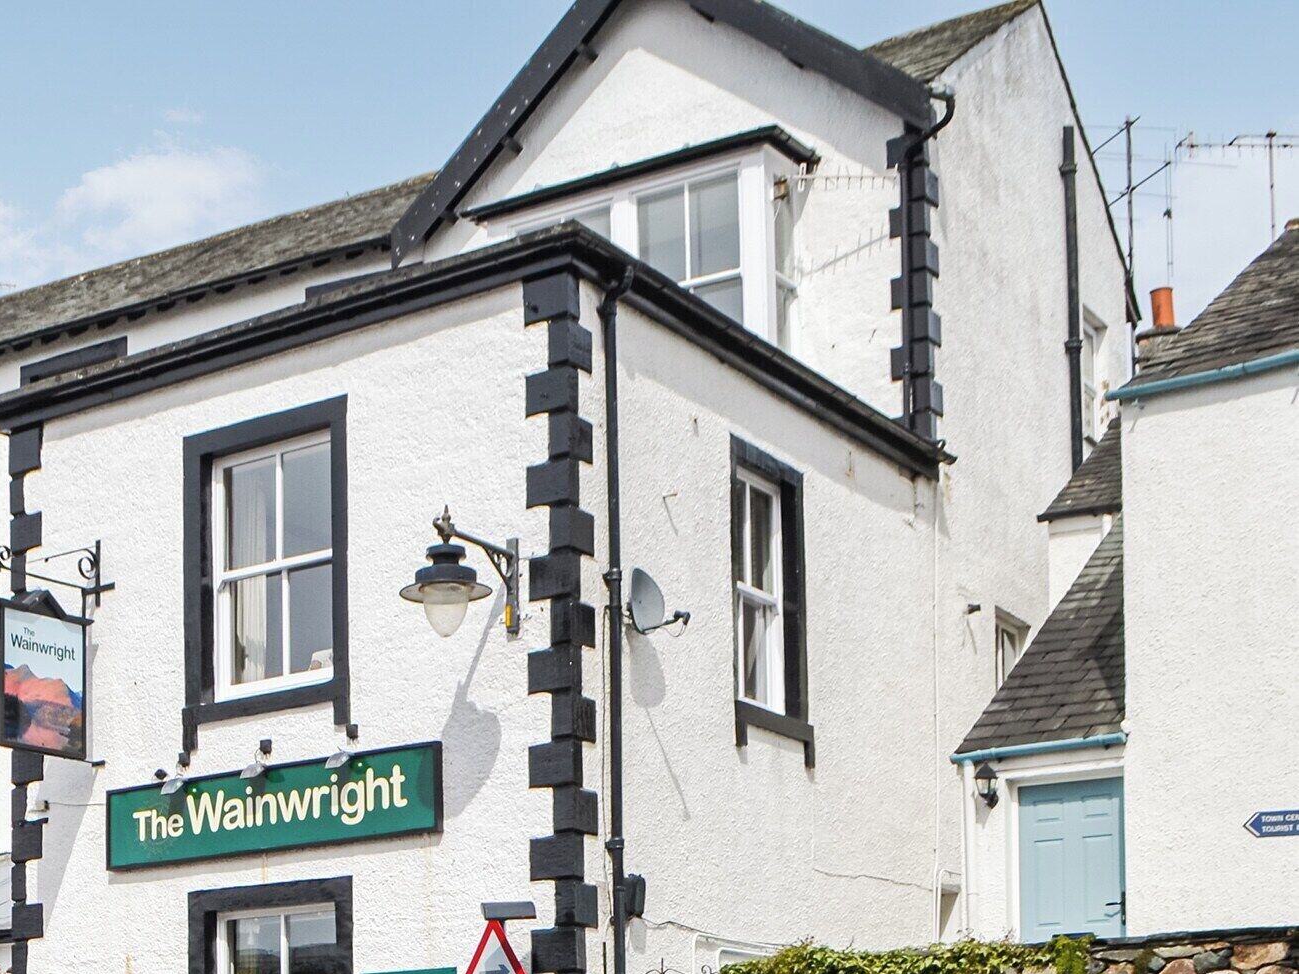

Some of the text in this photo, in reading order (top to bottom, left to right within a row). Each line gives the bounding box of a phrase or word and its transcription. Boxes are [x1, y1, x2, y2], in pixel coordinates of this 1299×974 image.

[23, 627, 35, 636] The
[10, 633, 76, 662] Wainwright
[132, 764, 408, 842] The Wainwright
[1261, 815, 1284, 823] TOWN
[1261, 824, 1294, 833] TOURIST
